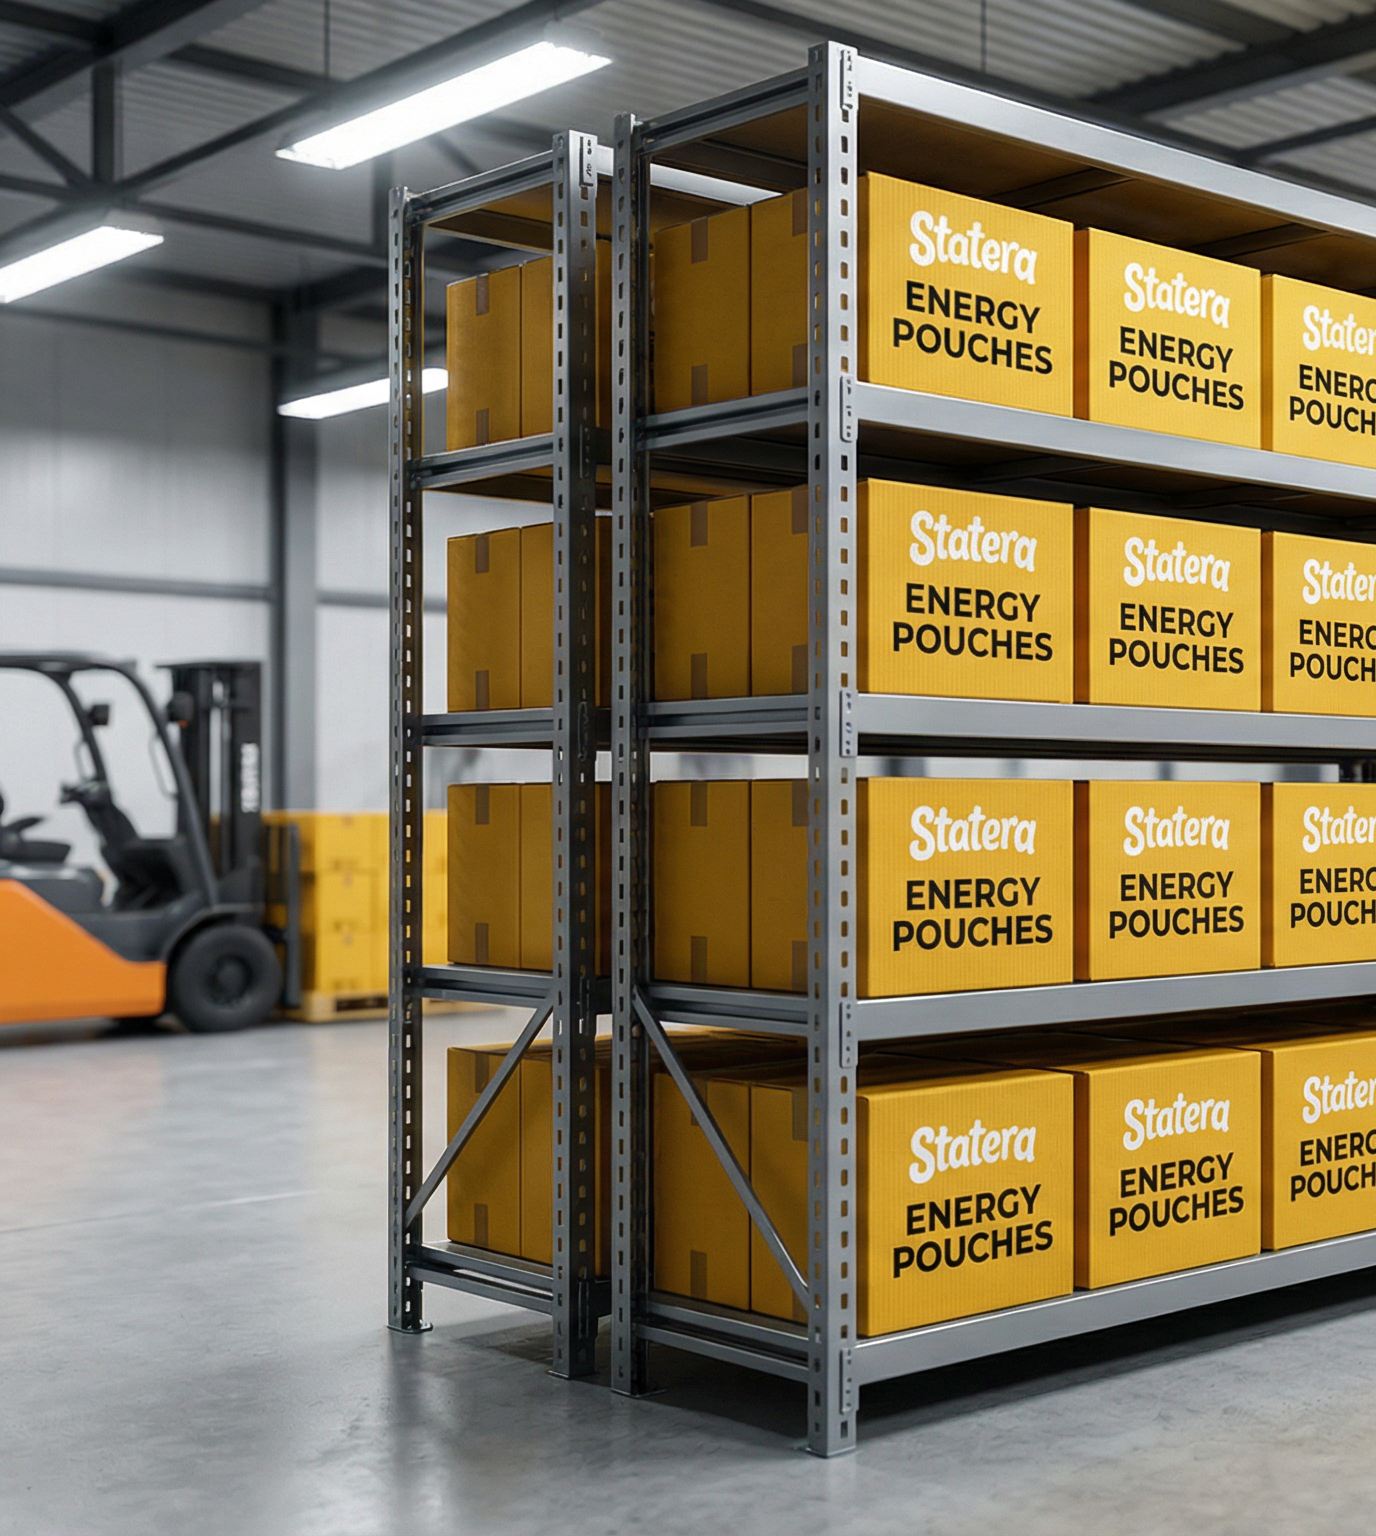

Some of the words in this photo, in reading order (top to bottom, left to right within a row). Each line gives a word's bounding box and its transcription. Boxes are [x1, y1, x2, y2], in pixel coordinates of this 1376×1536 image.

[909, 210, 1038, 285] Statera
[906, 279, 1041, 334] ENERGY
[1123, 261, 1231, 329] Statera
[893, 317, 1053, 375] POUCHES
[1119, 325, 1234, 374] ENERGY
[1109, 359, 1245, 411] POUCHES
[909, 509, 1038, 573] Statera
[1123, 536, 1231, 593] Statera
[906, 582, 1041, 623] ENERGY
[1120, 602, 1234, 639] ENERGY
[892, 621, 1053, 662] POUCHES
[1109, 637, 1245, 675] POUCHES
[909, 805, 1037, 862] Statera
[1123, 805, 1231, 857] Statera
[906, 876, 1041, 911] ENERGY
[1120, 870, 1234, 902] ENERGY
[892, 913, 1054, 952] POUCHES
[1109, 905, 1245, 940] POUCHES
[1122, 1092, 1231, 1151] Statera
[909, 1119, 1037, 1185] Statera
[1120, 1151, 1234, 1199] ENERGY
[906, 1183, 1042, 1237] ENERGY
[1109, 1185, 1245, 1237] POUCHES
[893, 1220, 1054, 1279] POUCHES
